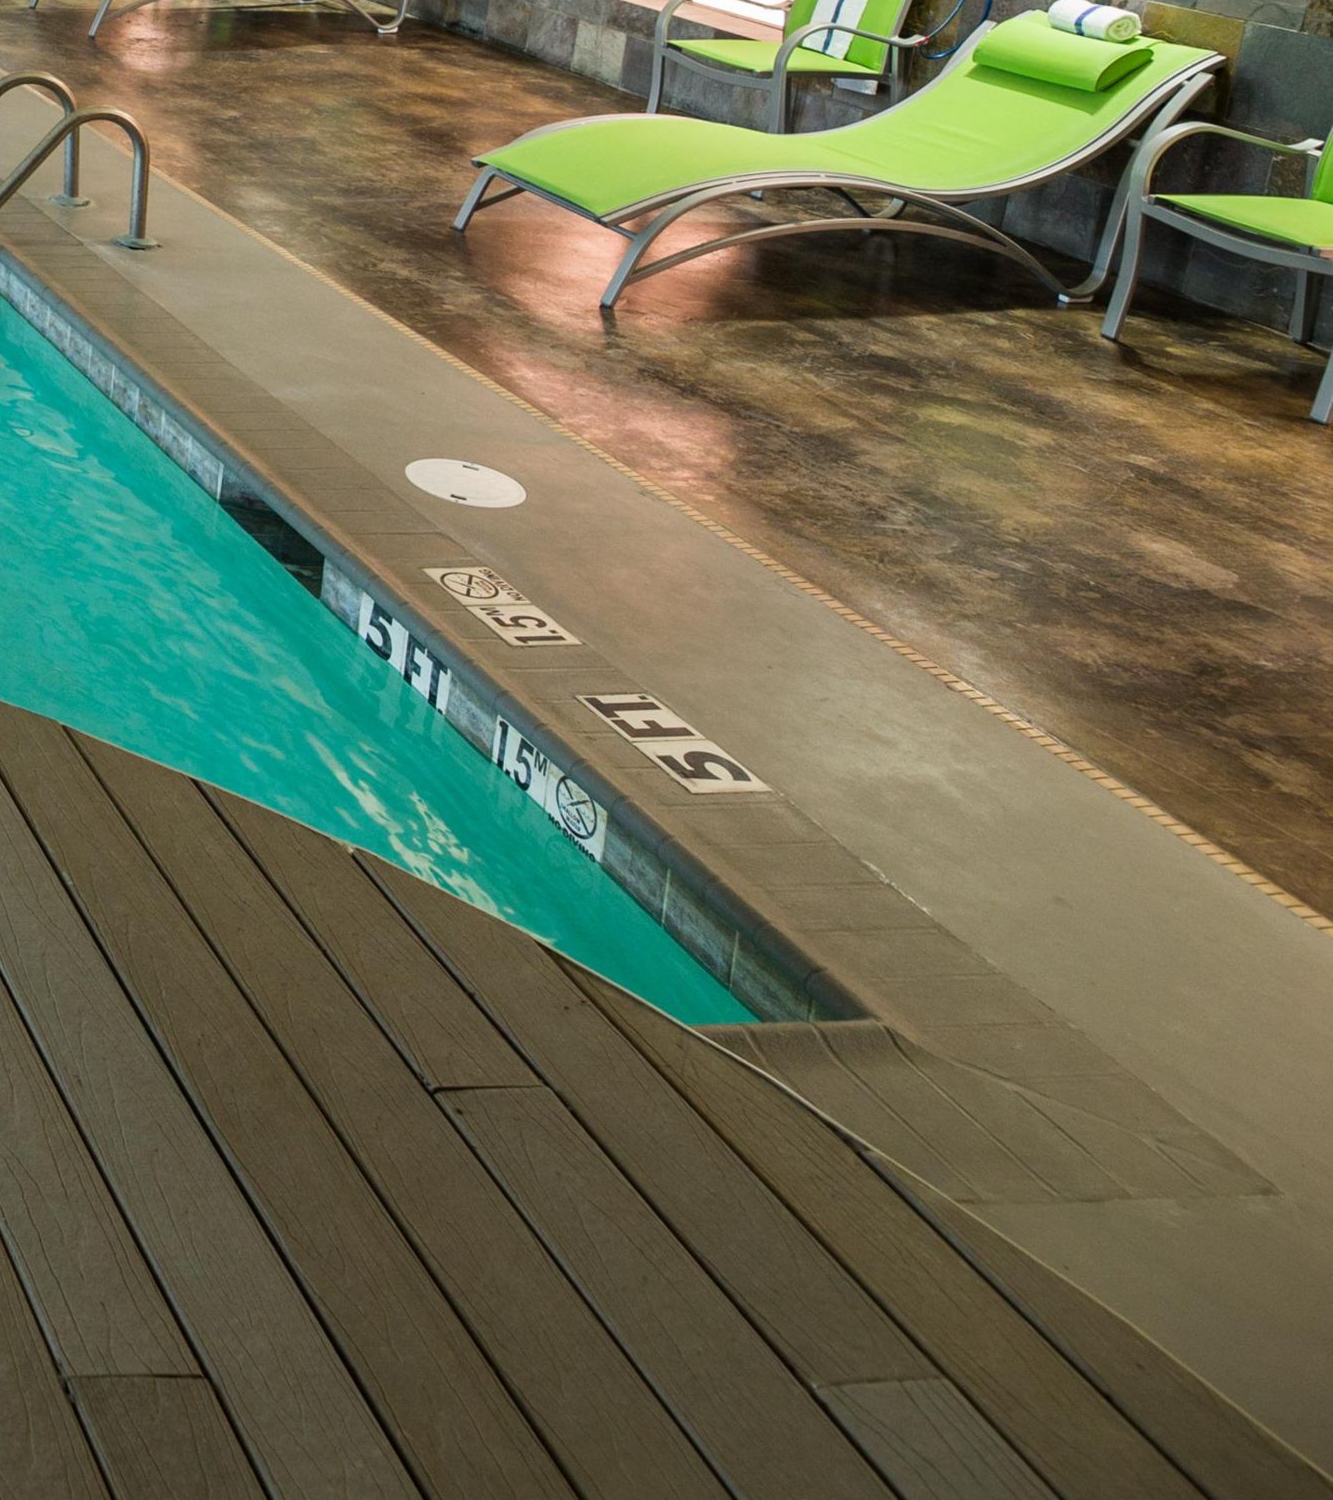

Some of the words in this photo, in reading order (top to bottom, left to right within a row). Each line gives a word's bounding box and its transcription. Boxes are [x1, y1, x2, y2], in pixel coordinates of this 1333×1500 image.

[478, 568, 513, 591] DIVING
[507, 591, 526, 601] NO
[365, 601, 393, 661] 5
[655, 750, 752, 782] 5
[548, 813, 561, 830] NO
[563, 829, 596, 863] DIVING
